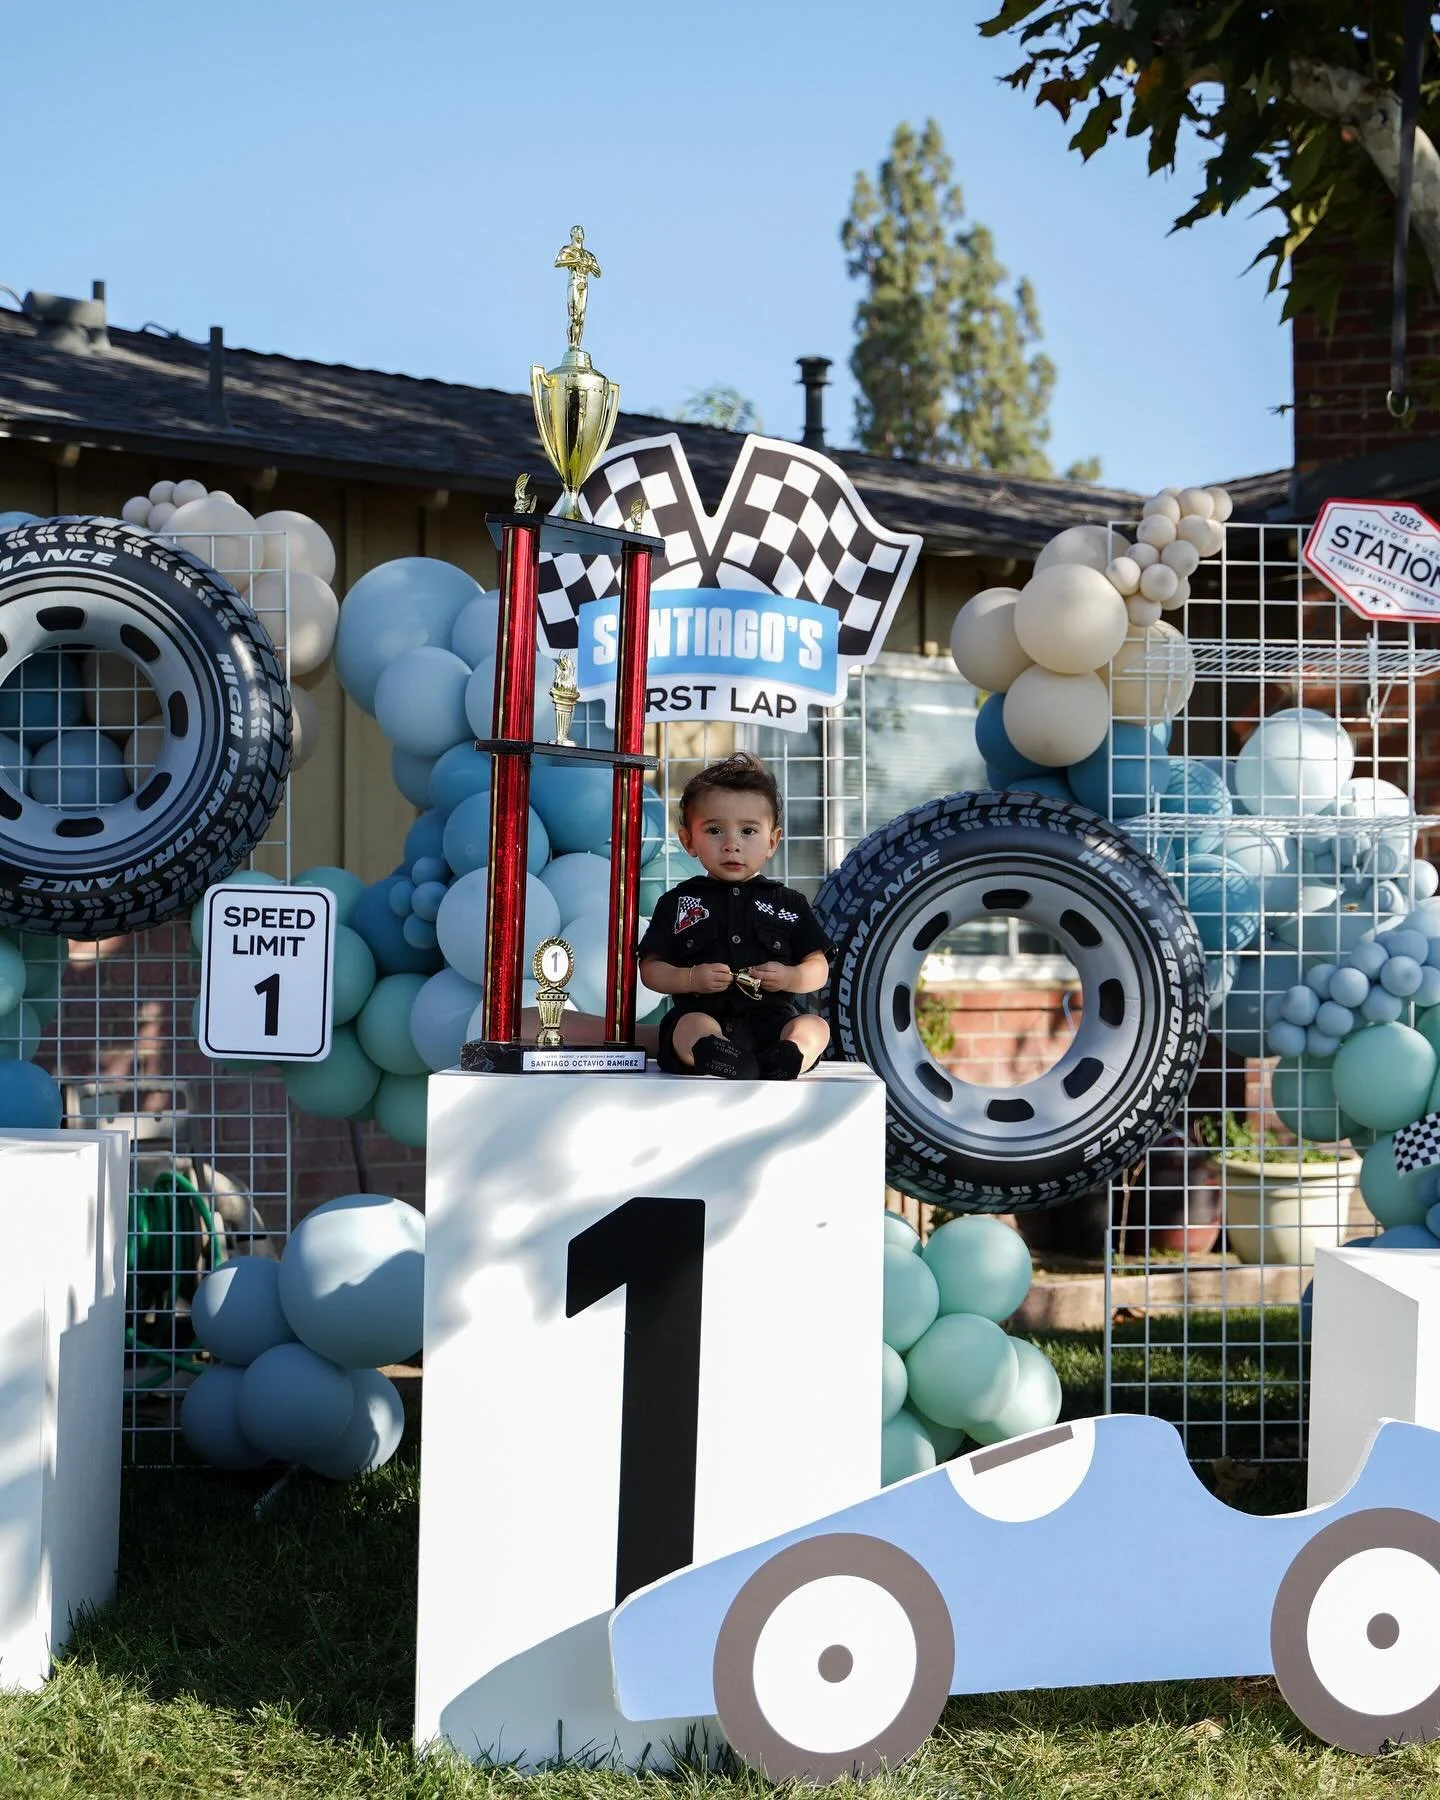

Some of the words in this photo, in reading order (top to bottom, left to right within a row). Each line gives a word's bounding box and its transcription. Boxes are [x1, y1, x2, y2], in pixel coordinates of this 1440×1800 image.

[1359, 520, 1409, 544] TAVITO'S
[1391, 511, 1422, 532] 2022
[1338, 560, 1365, 575] PUMPS
[1368, 573, 1397, 589] ALWAYS
[1400, 587, 1436, 605] RUNNING
[593, 607, 823, 670] SNTIAGO'S
[216, 652, 245, 734] HIGH
[645, 685, 717, 713] RST
[731, 687, 798, 719] LAP
[20, 746, 241, 894] PERFORMANCE
[1077, 850, 1151, 911] HIGH
[224, 906, 316, 931] SPEED
[232, 935, 305, 958] LIMIT
[550, 951, 560, 973] 1
[838, 850, 940, 1062] RFORMANCE
[253, 973, 281, 1037] 1
[1083, 917, 1185, 1164] PERFORMANCE
[565, 1197, 706, 1610] 1
